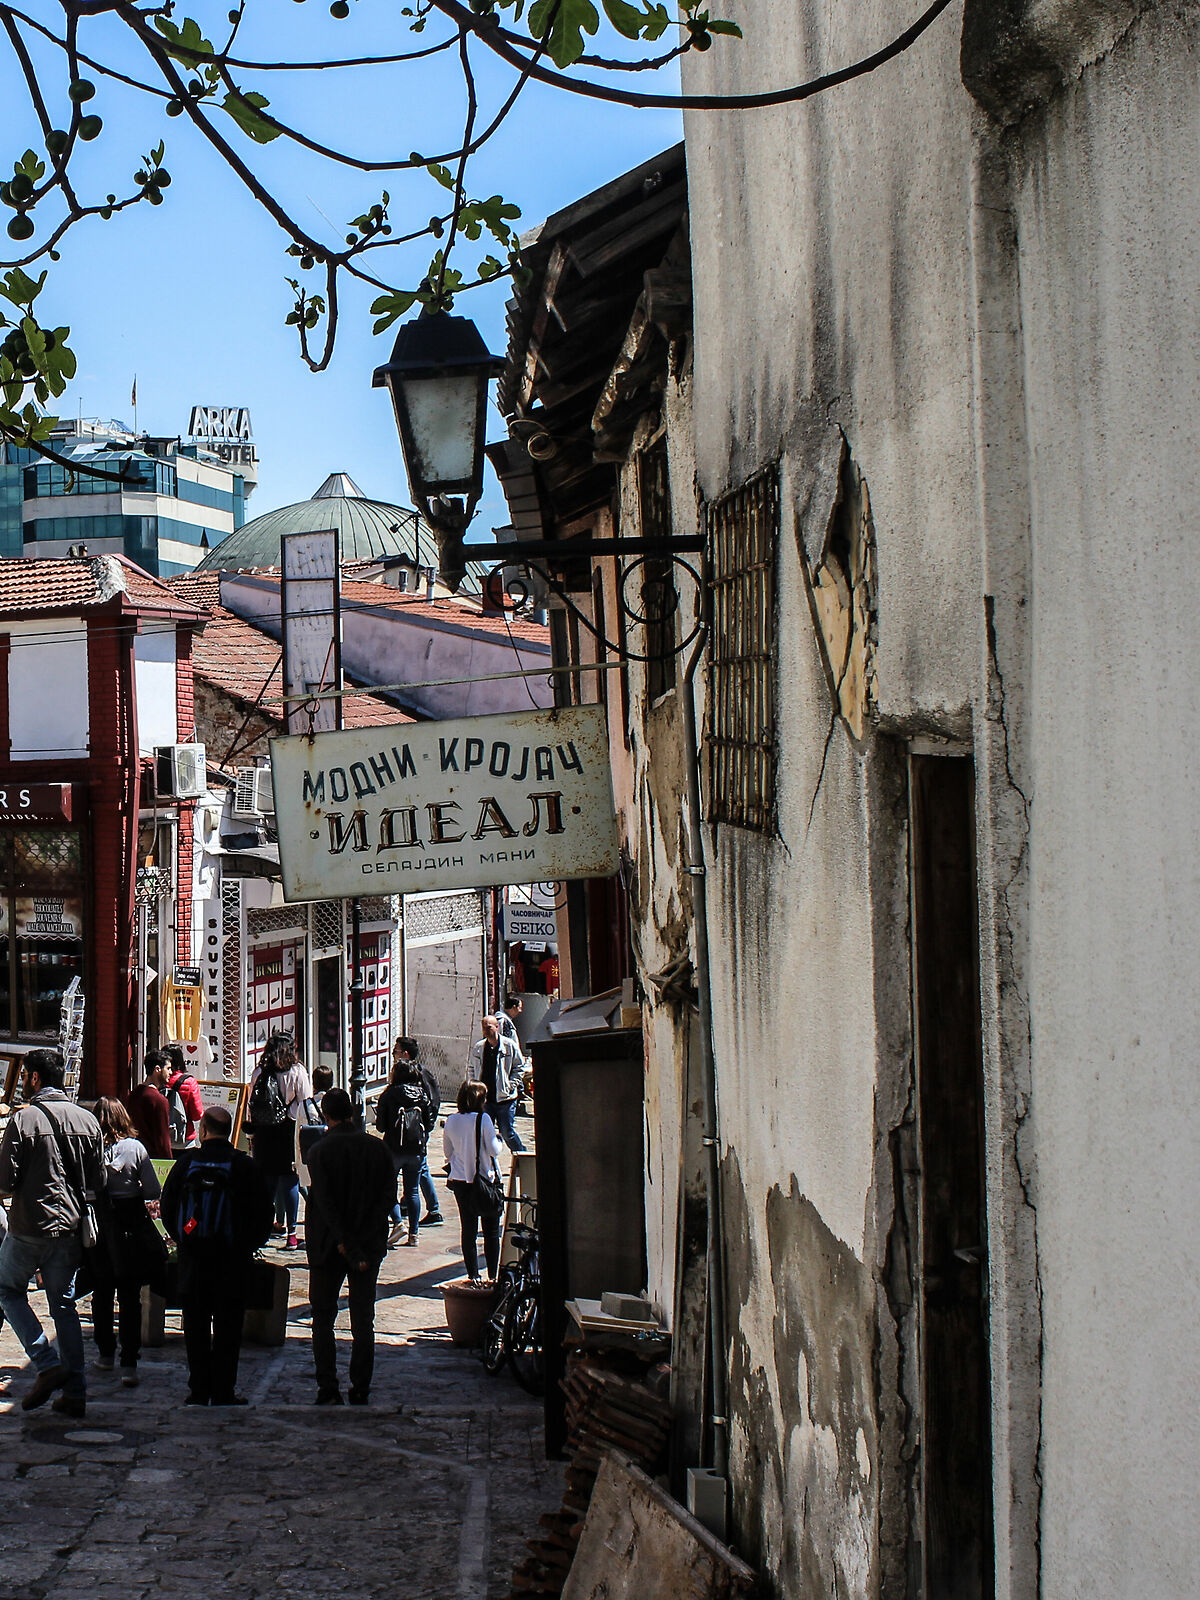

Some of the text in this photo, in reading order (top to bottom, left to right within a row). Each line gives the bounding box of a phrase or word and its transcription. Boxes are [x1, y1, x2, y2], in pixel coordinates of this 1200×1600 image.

[188, 406, 253, 437] ARKA
[207, 443, 260, 465] HOTEL
[302, 738, 585, 803] МОДНИ КРОЈАЧ
[323, 790, 566, 855] ИДЕАЛ
[361, 849, 536, 875] СЕЛАЈДИН МАНИ
[511, 910, 553, 918] ЧАСОВНИЧАР
[510, 922, 555, 936] SEIKO
[207, 918, 219, 1063] SOUVENIRS
